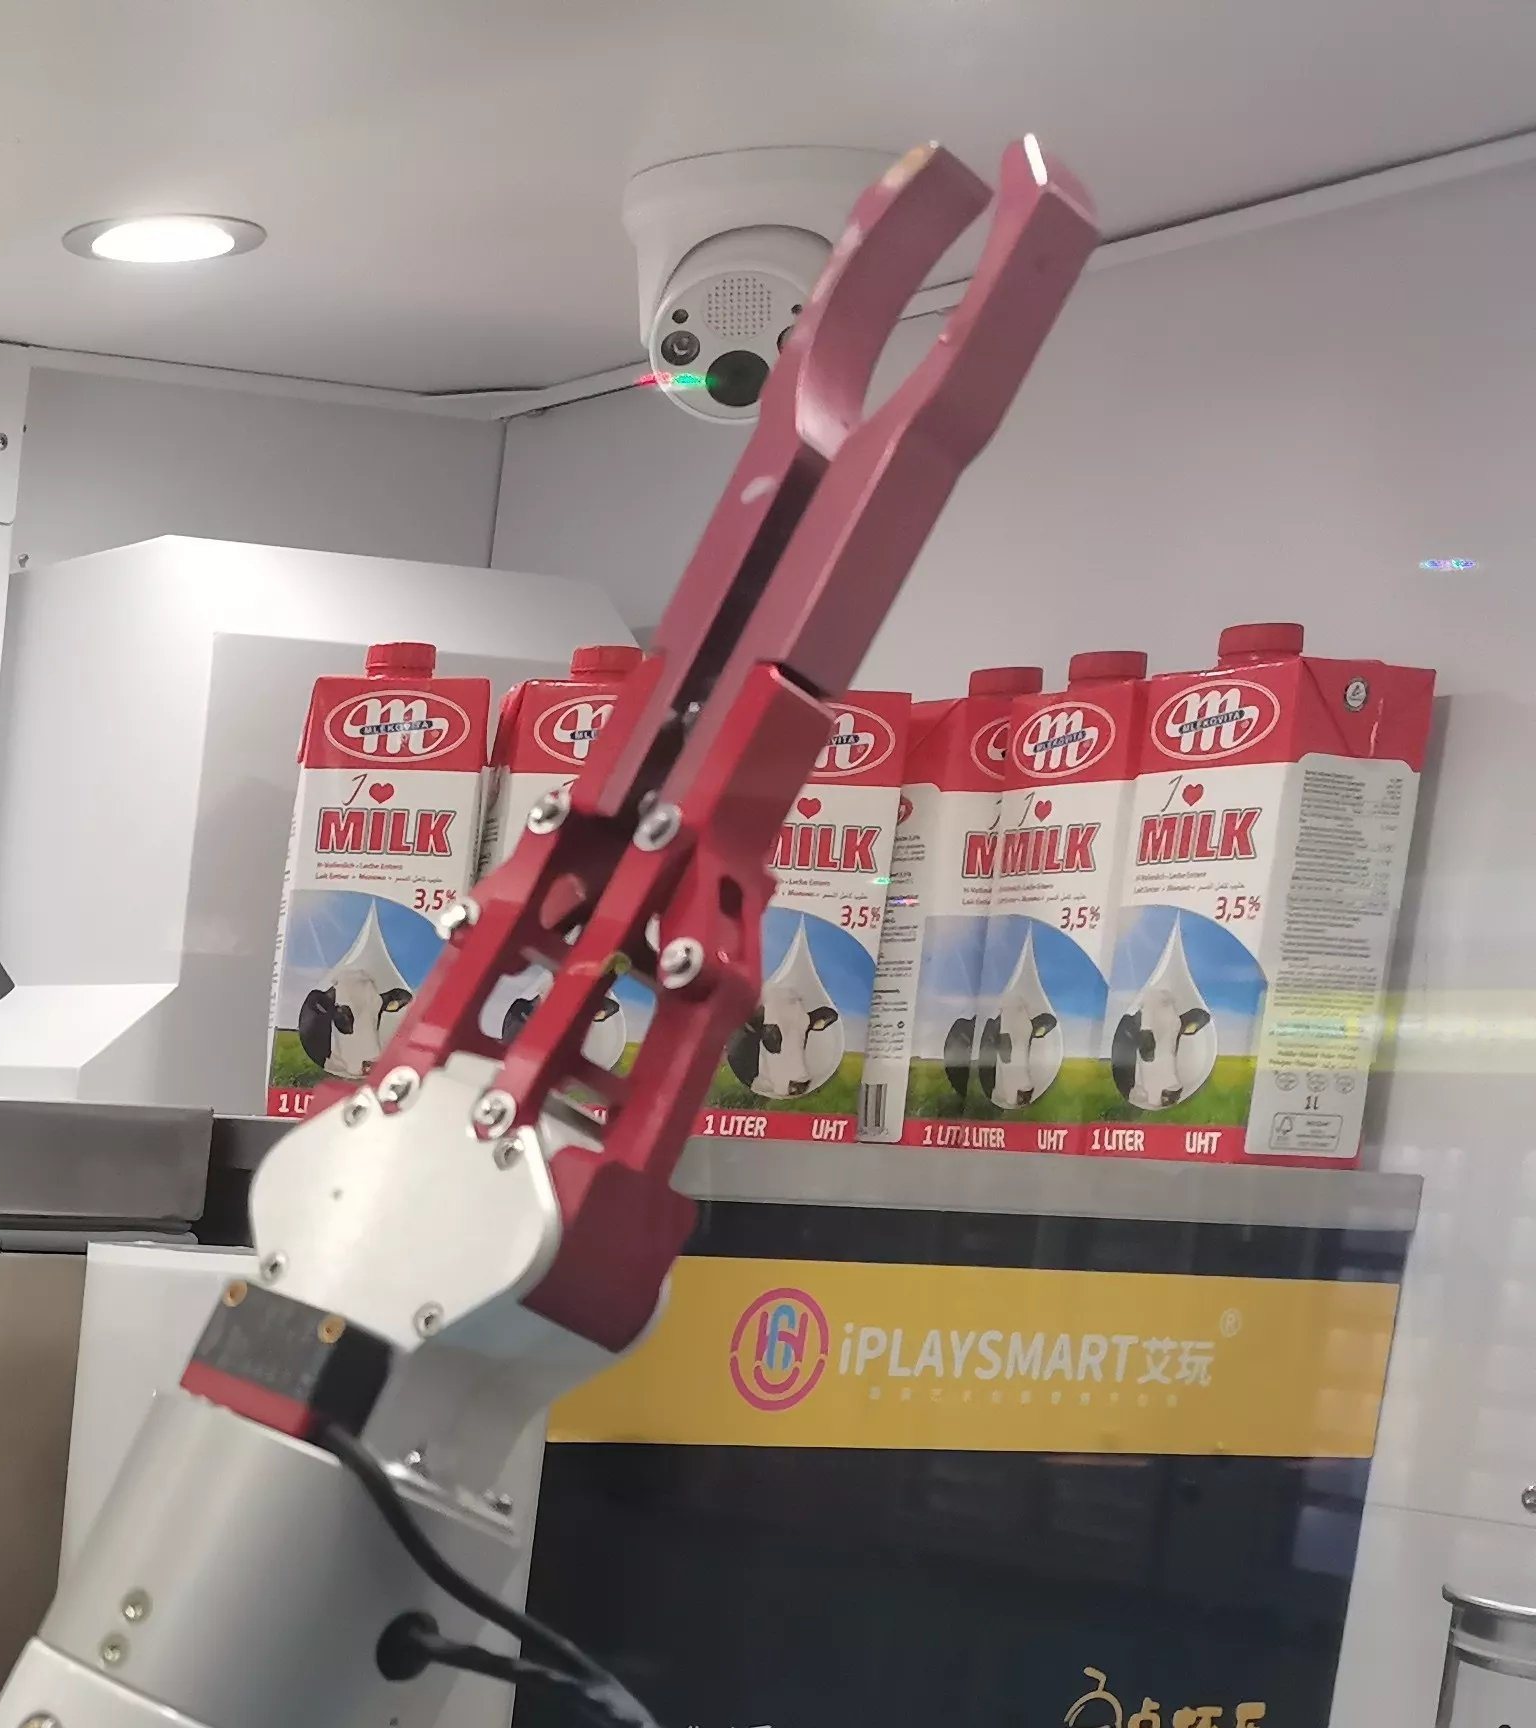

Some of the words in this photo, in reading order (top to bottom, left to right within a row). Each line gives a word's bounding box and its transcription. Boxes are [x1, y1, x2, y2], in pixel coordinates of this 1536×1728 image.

[316, 807, 457, 857] MILK
[1000, 823, 1101, 878] MILK
[1136, 807, 1262, 866] MILK
[703, 1116, 715, 1134] 1
[719, 1116, 766, 1138] LITER
[811, 1119, 848, 1140] UHT
[972, 1127, 1005, 1148] LITER
[1037, 1129, 1068, 1151] UHT
[1091, 1128, 1101, 1150] 1
[1103, 1128, 1145, 1152] LITER
[1185, 1131, 1222, 1155] UHT
